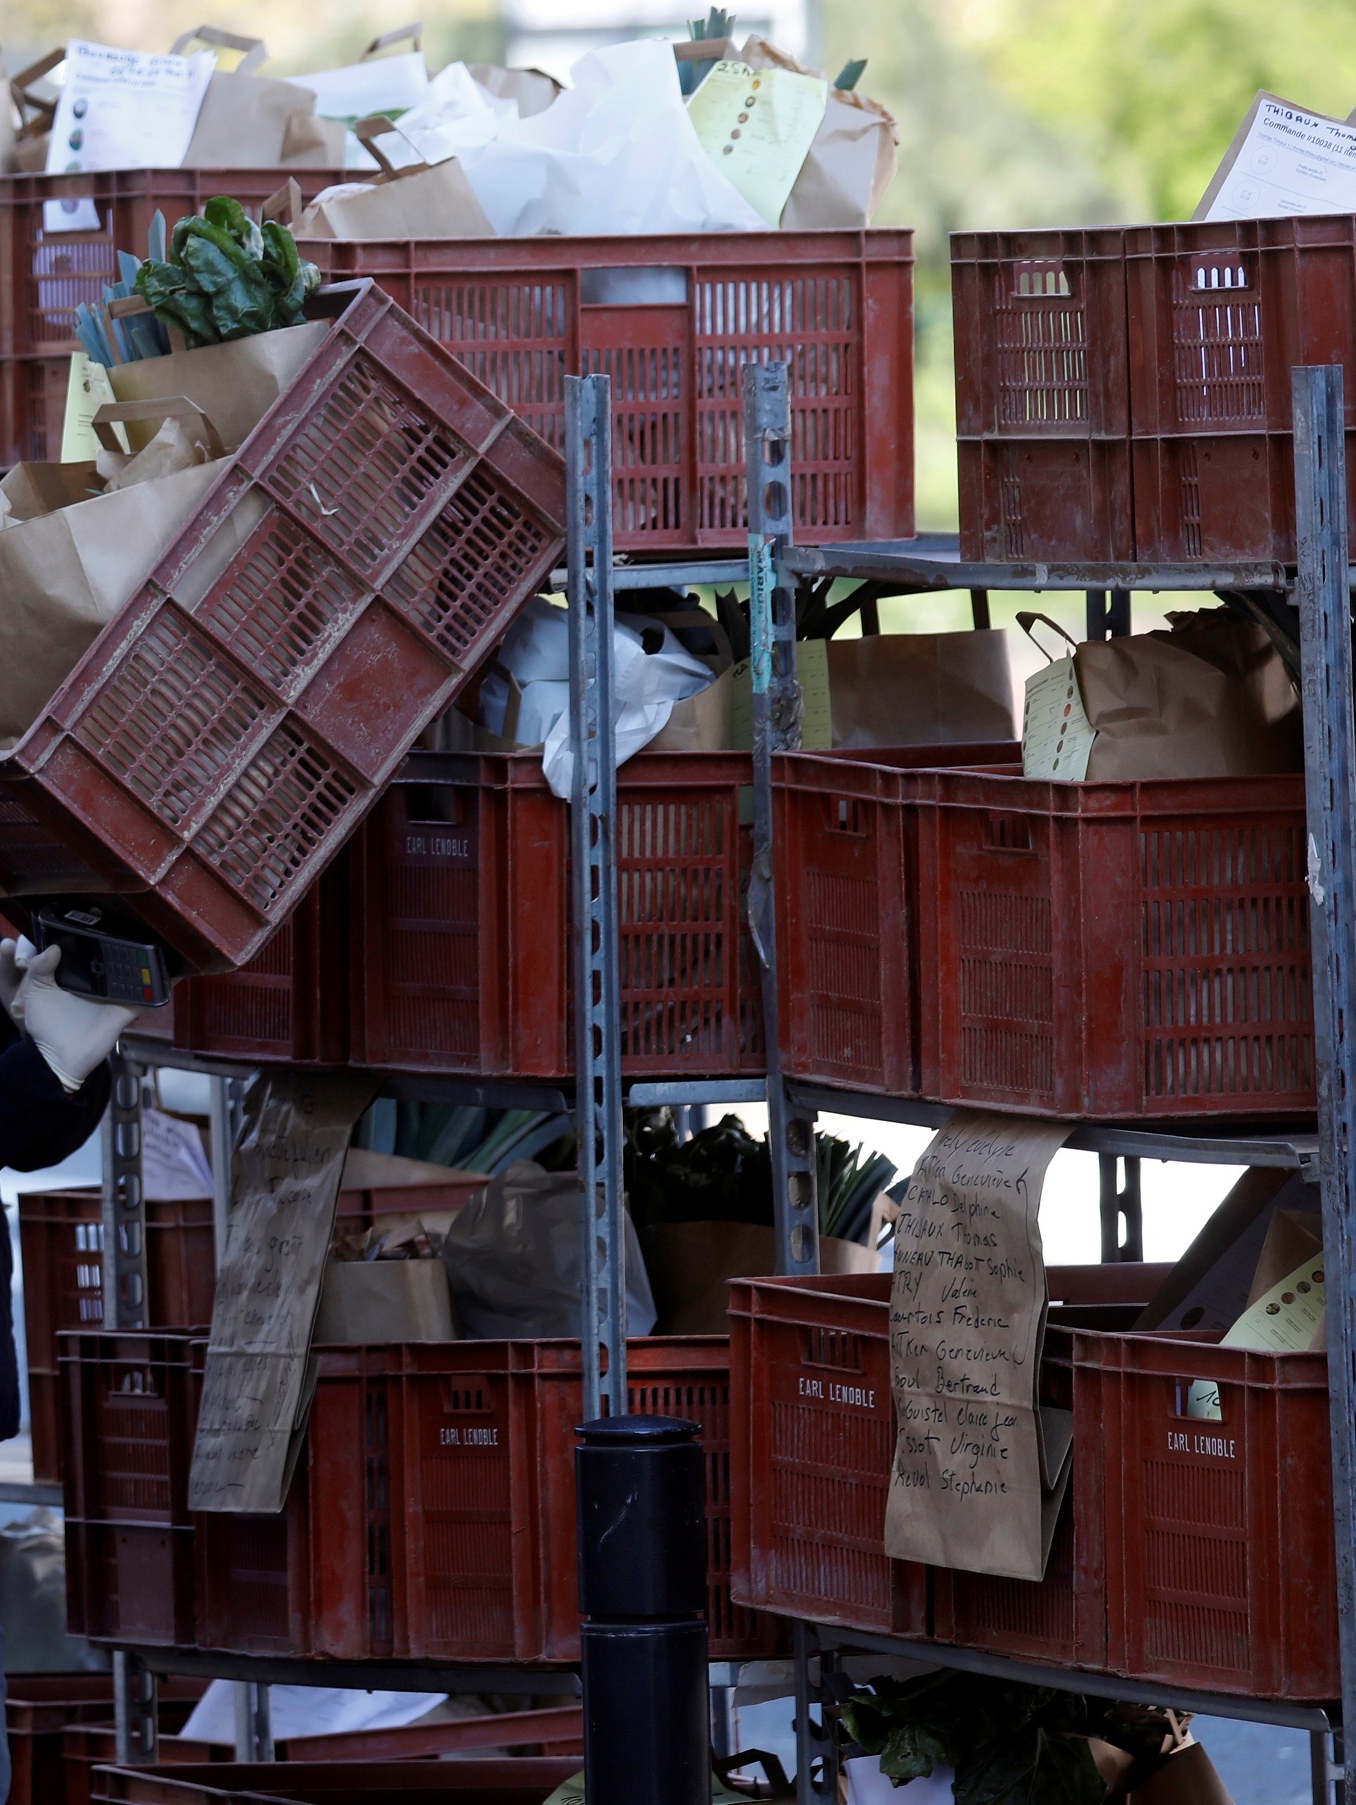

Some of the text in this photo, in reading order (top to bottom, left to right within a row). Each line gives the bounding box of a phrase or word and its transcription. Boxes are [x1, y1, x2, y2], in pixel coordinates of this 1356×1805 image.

[1263, 117, 1306, 140] Commande
[1307, 134, 1333, 149] #10038
[407, 836, 468, 857] EARL LENOBLE
[799, 1377, 875, 1408] EARL LENOBLE
[440, 1428, 499, 1446] EARL LENOBLE
[1168, 1431, 1235, 1458] EARL LENOBLE
